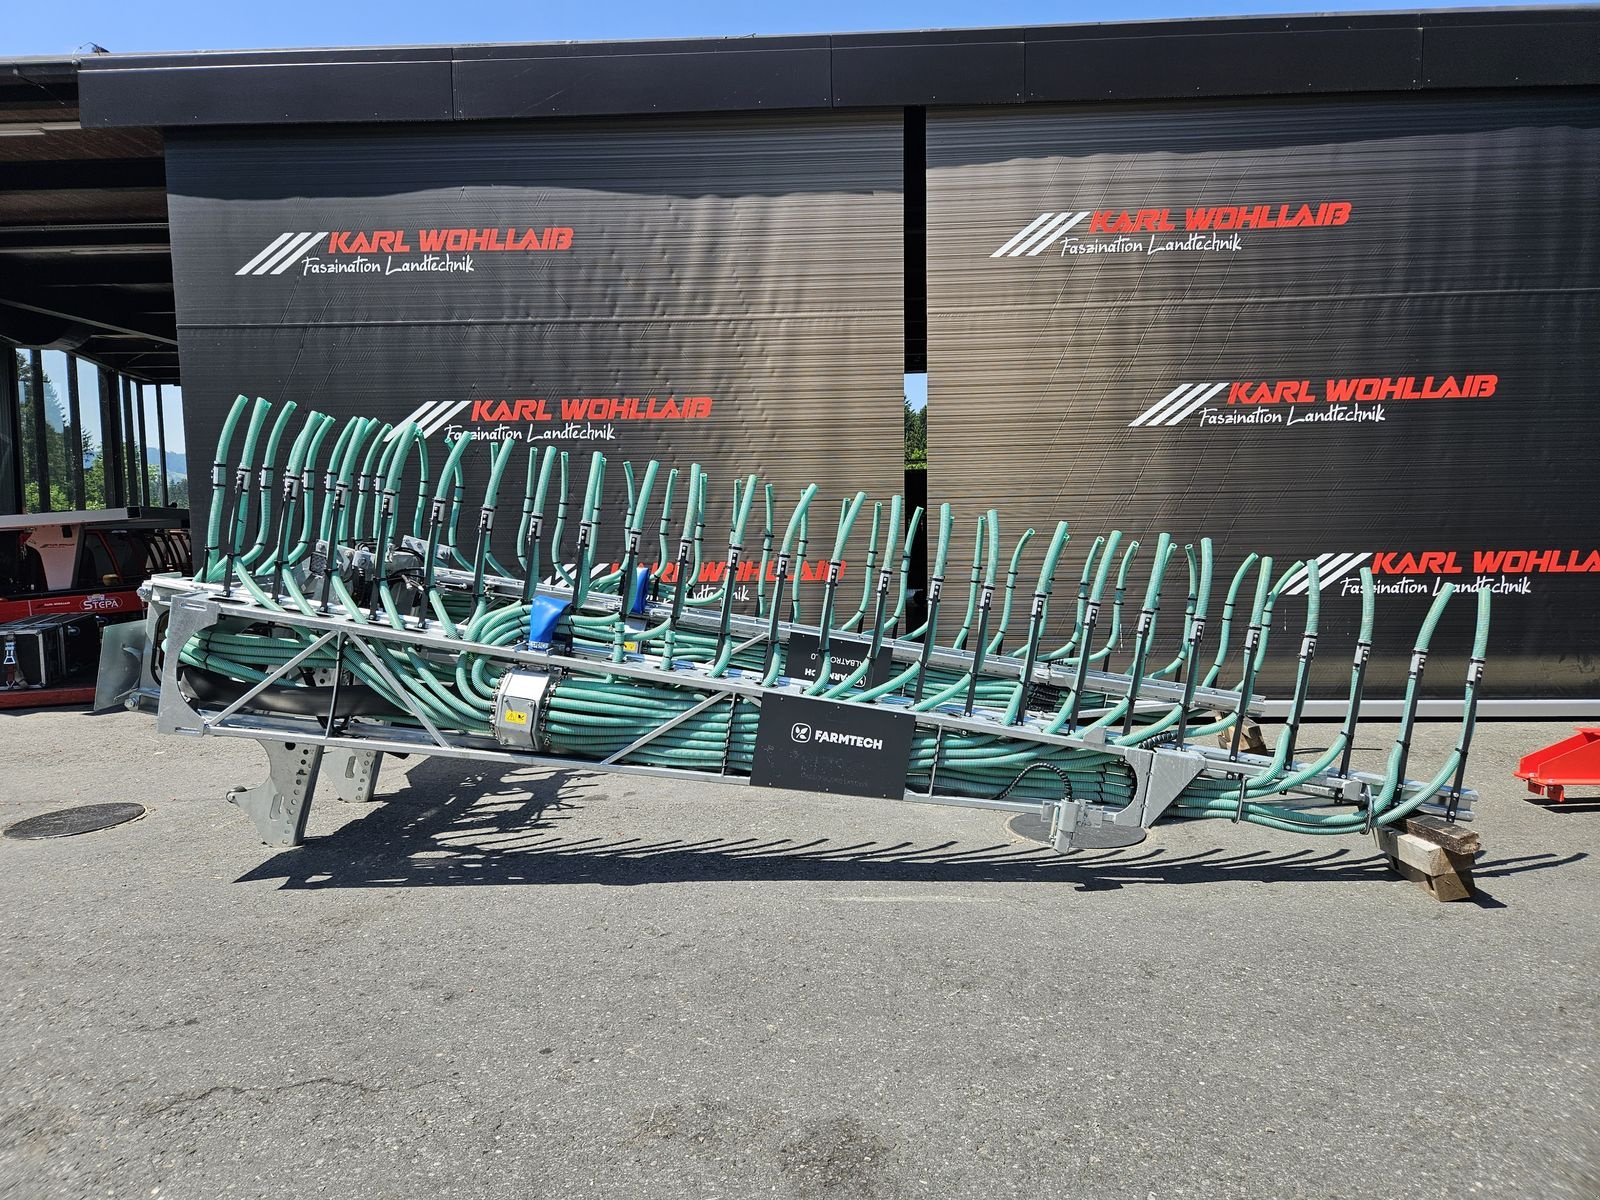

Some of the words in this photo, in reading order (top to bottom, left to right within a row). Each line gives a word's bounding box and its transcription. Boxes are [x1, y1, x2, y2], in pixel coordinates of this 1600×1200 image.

[1089, 208, 1175, 233] KARL
[1185, 202, 1352, 231] WOHLLAIB
[328, 231, 410, 253] KARL
[419, 227, 573, 251] WOHLLAIB
[1060, 236, 1143, 257] Faszination
[1147, 232, 1242, 255] Landtechnik
[302, 257, 381, 276] Faszination
[385, 253, 475, 275] Landtechnik
[1227, 380, 1316, 405] KARL
[1326, 374, 1498, 402] WOHLLAIB
[471, 399, 552, 421] KARL
[561, 397, 713, 420] WOHLLAIB
[1199, 406, 1282, 427] Faszination
[1287, 403, 1386, 426] Landtechnik
[444, 424, 522, 441] Fazination
[526, 422, 616, 442] Landtechnik
[1371, 551, 1463, 575] KARL
[83, 600, 119, 610] STEPA
[814, 730, 883, 750] FARMTECH
